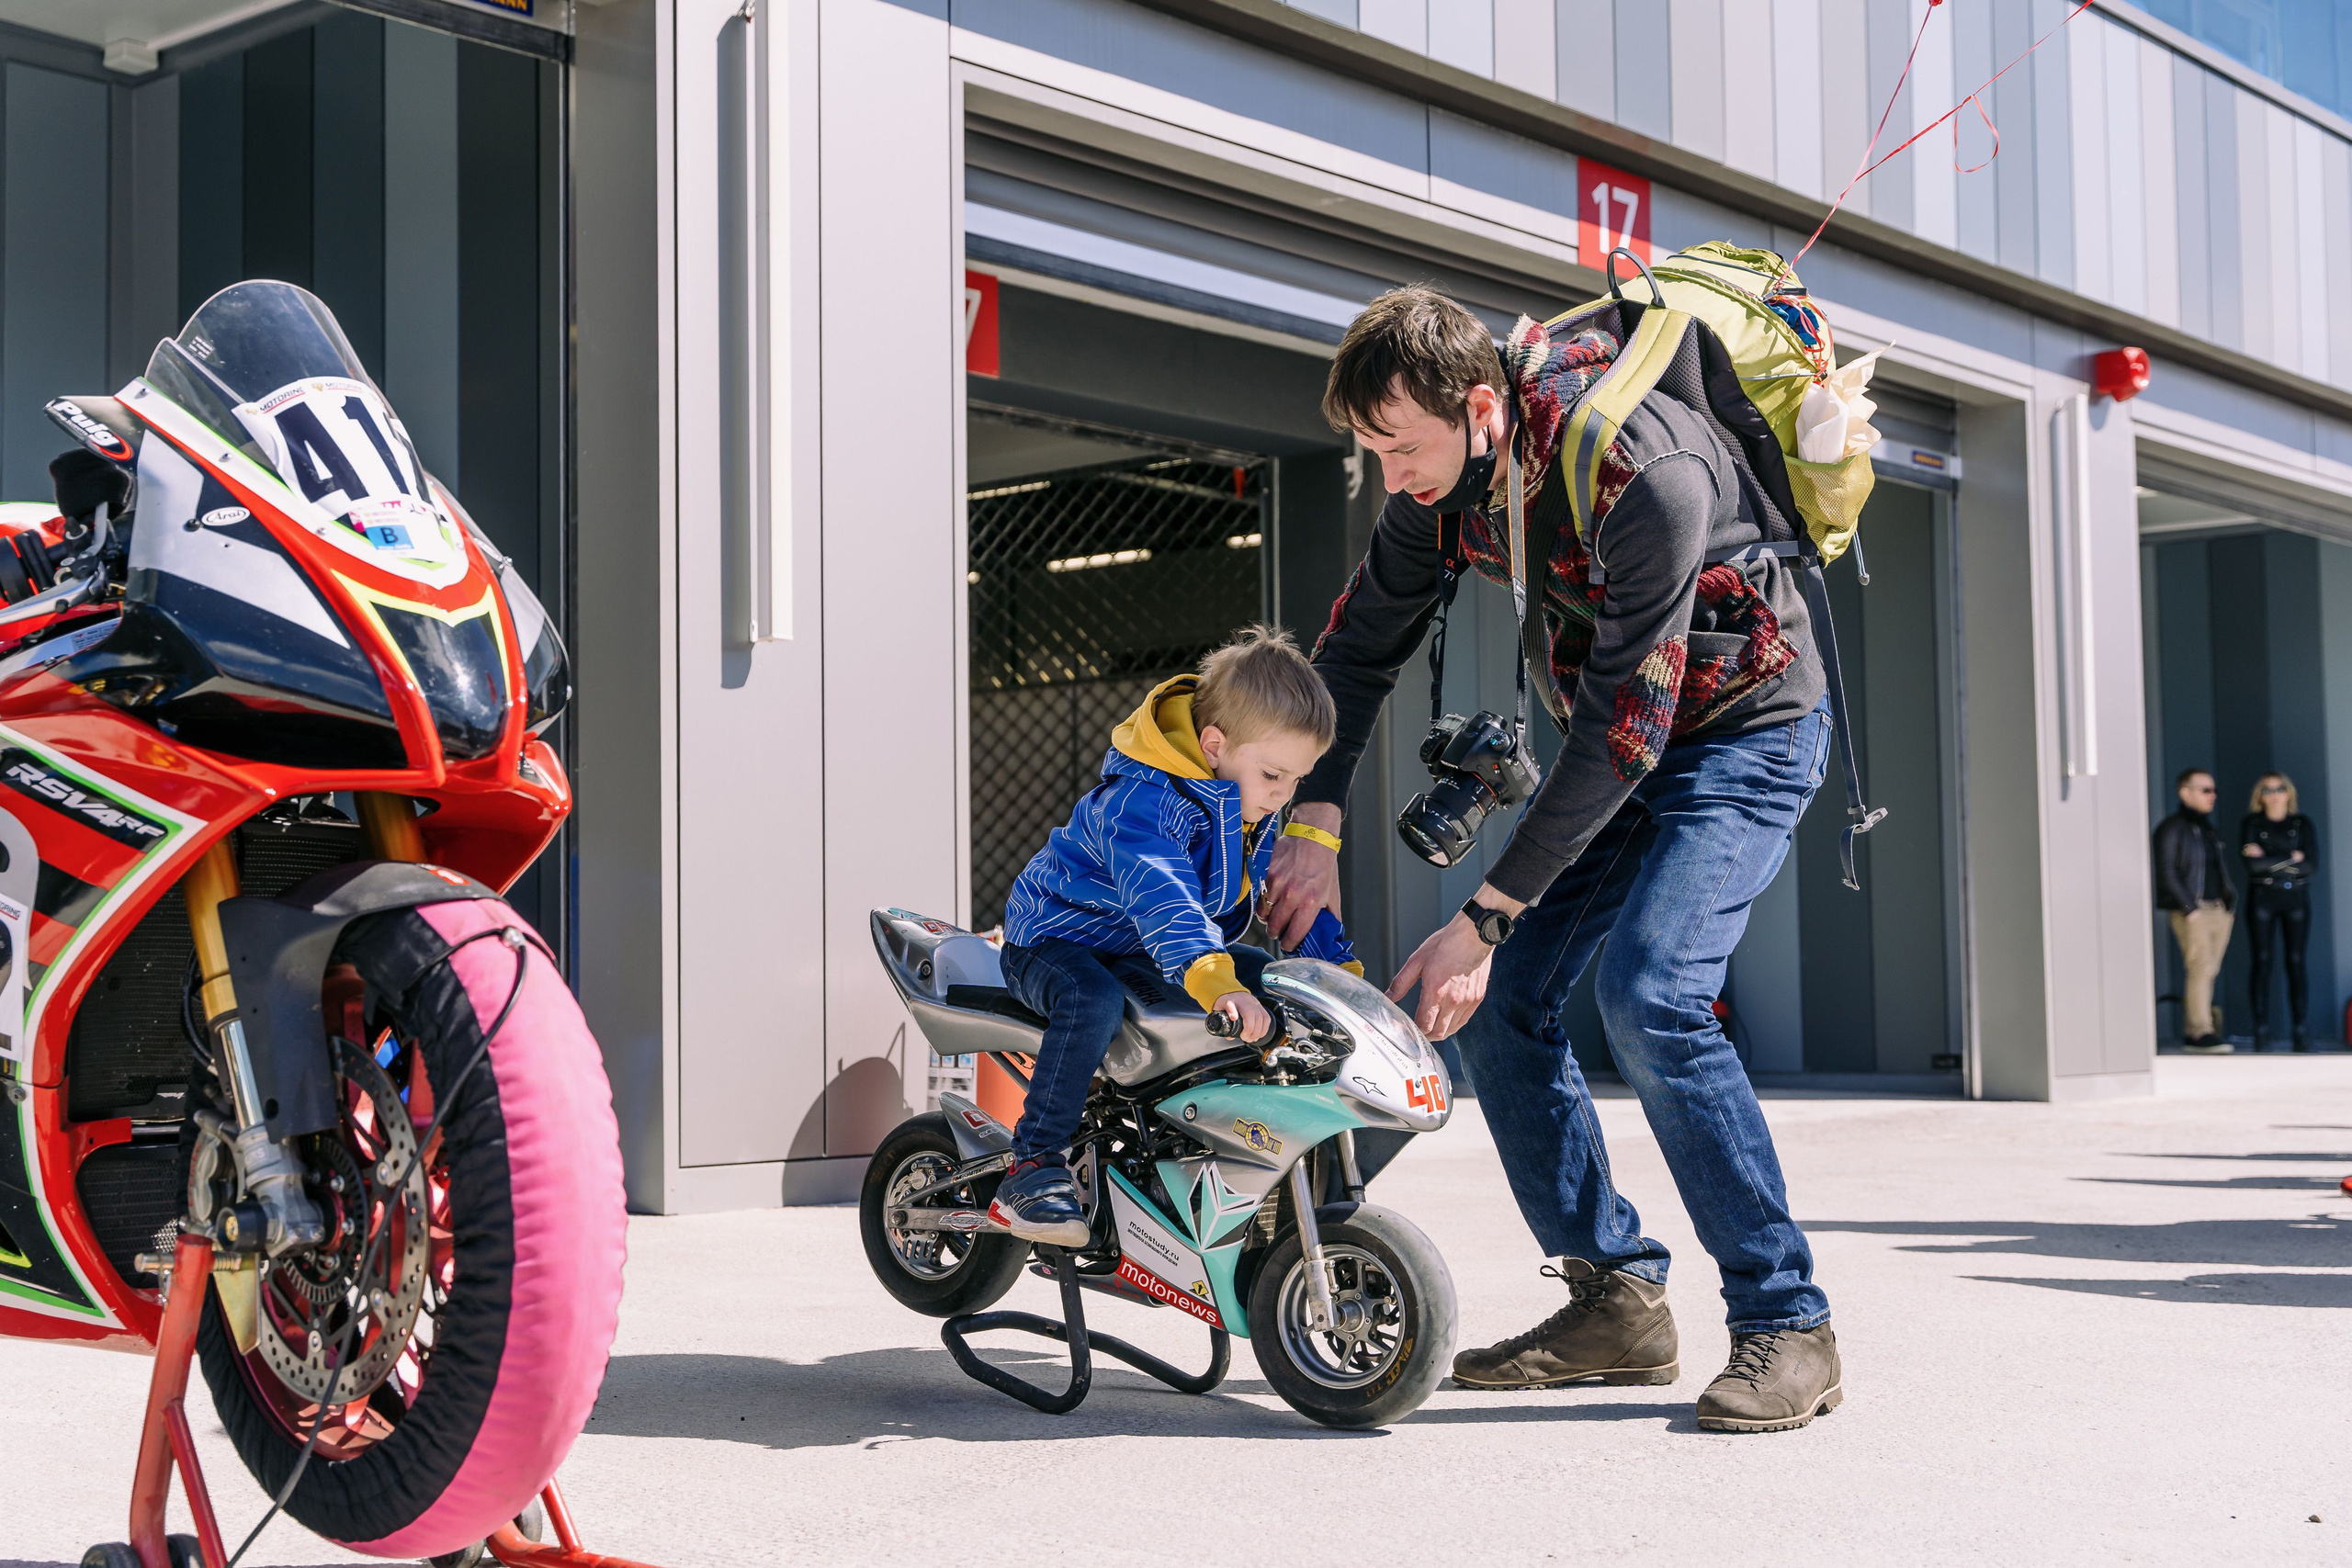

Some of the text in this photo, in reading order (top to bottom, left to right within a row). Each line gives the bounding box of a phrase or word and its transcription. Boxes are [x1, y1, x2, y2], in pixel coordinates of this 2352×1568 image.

[1591, 182, 1639, 260] 17
[52, 400, 120, 446] Puig
[207, 510, 246, 523] Arai
[380, 526, 399, 544] B
[1118, 971, 1167, 1008] YAMAHA
[1405, 1074, 1448, 1114] 40
[1129, 1221, 1180, 1261] motostudy.ru
[1121, 1261, 1217, 1323] motonews
